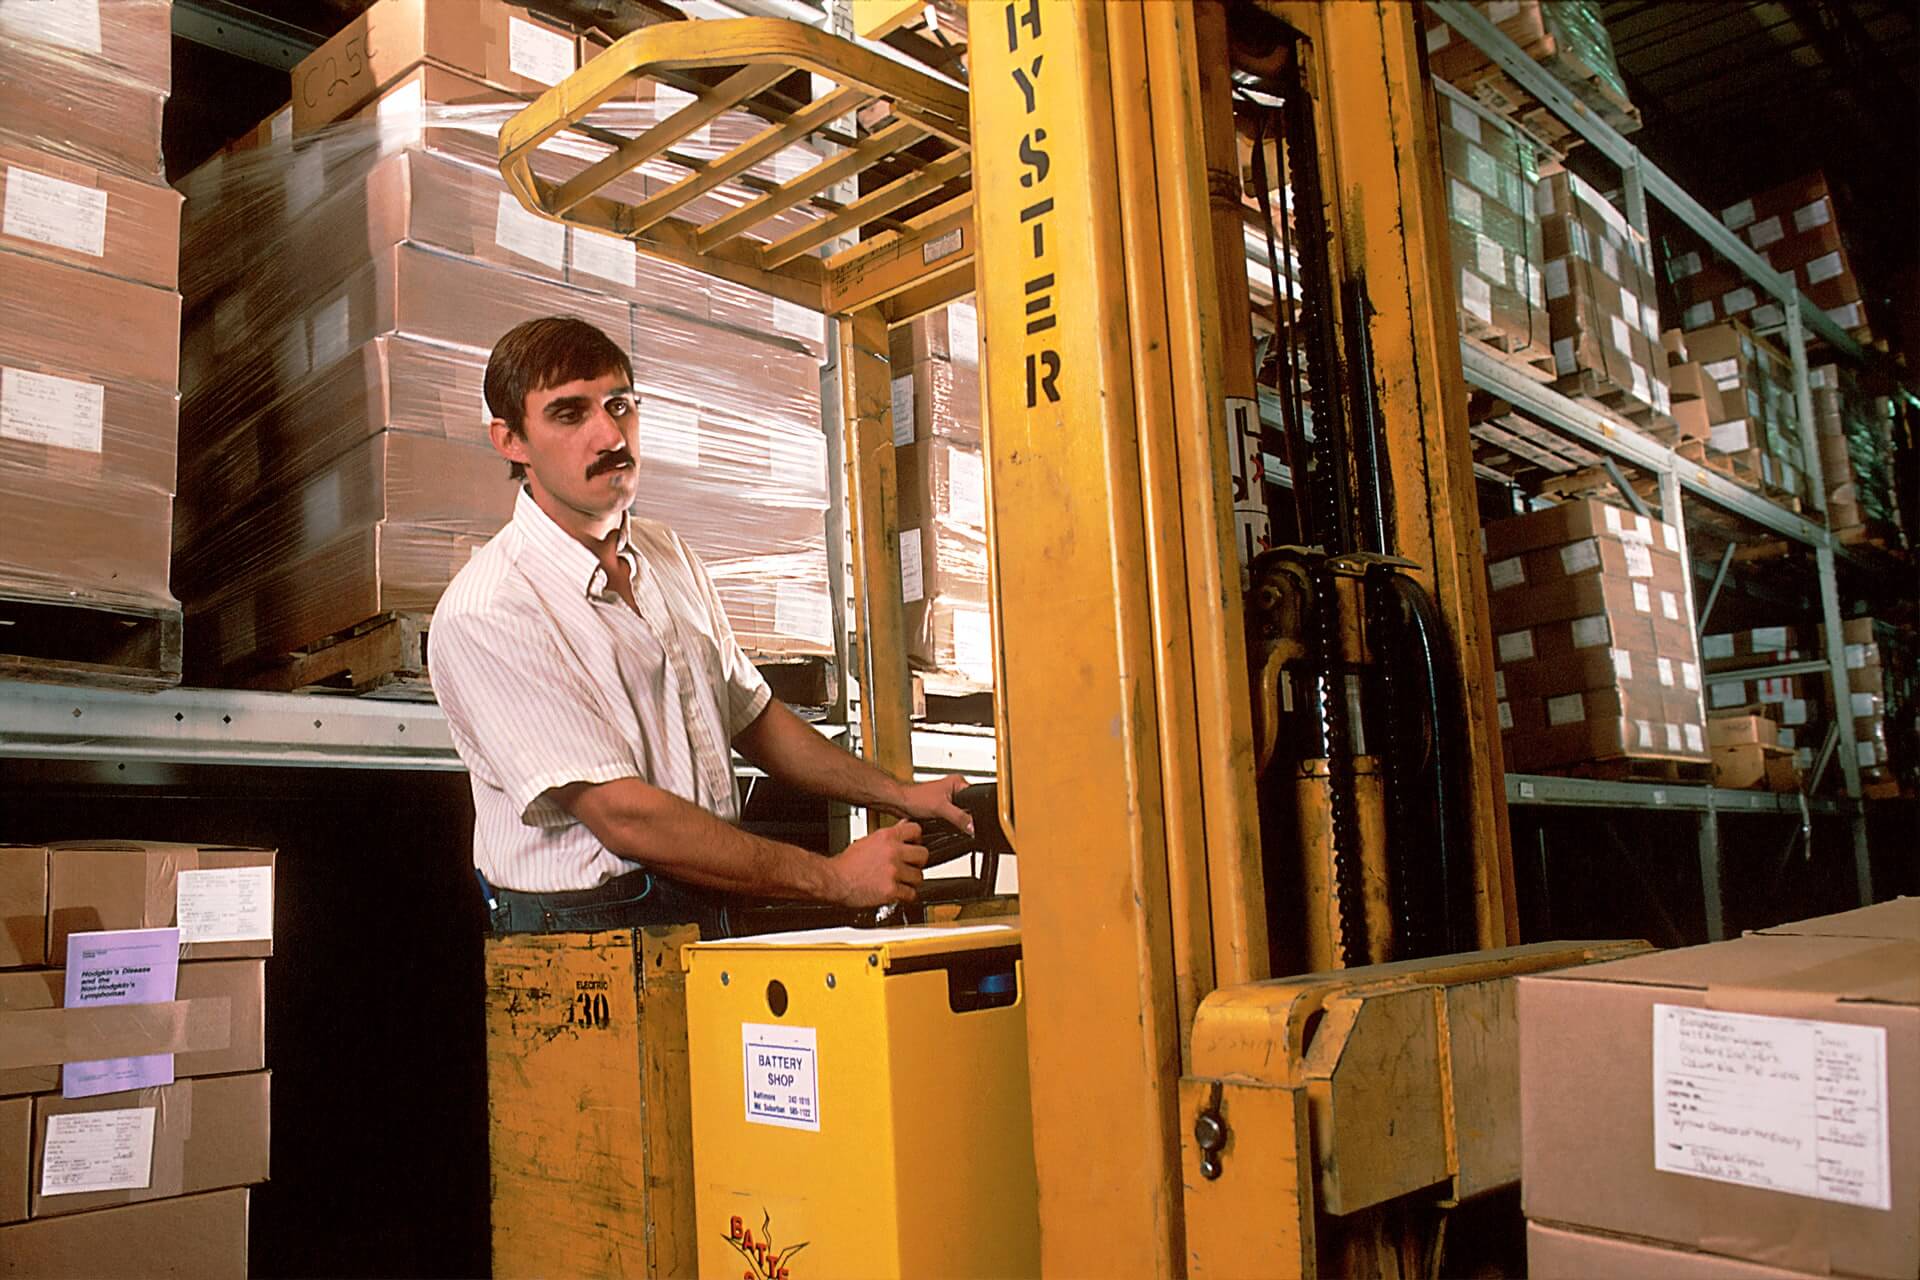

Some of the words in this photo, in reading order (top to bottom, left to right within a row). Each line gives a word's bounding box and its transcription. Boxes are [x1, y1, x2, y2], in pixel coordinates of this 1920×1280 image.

[1005, 0, 1062, 408] HYSTER
[81, 968, 119, 978] Hodgkin's
[122, 967, 151, 975] Disease
[81, 977, 96, 985] and
[576, 981, 608, 990] ELECTRIC
[80, 982, 136, 992] Non-Hodgkin's
[80, 990, 126, 1000] Lymphomas
[758, 1054, 802, 1070] BATTERY
[768, 1072, 794, 1087] SHOP
